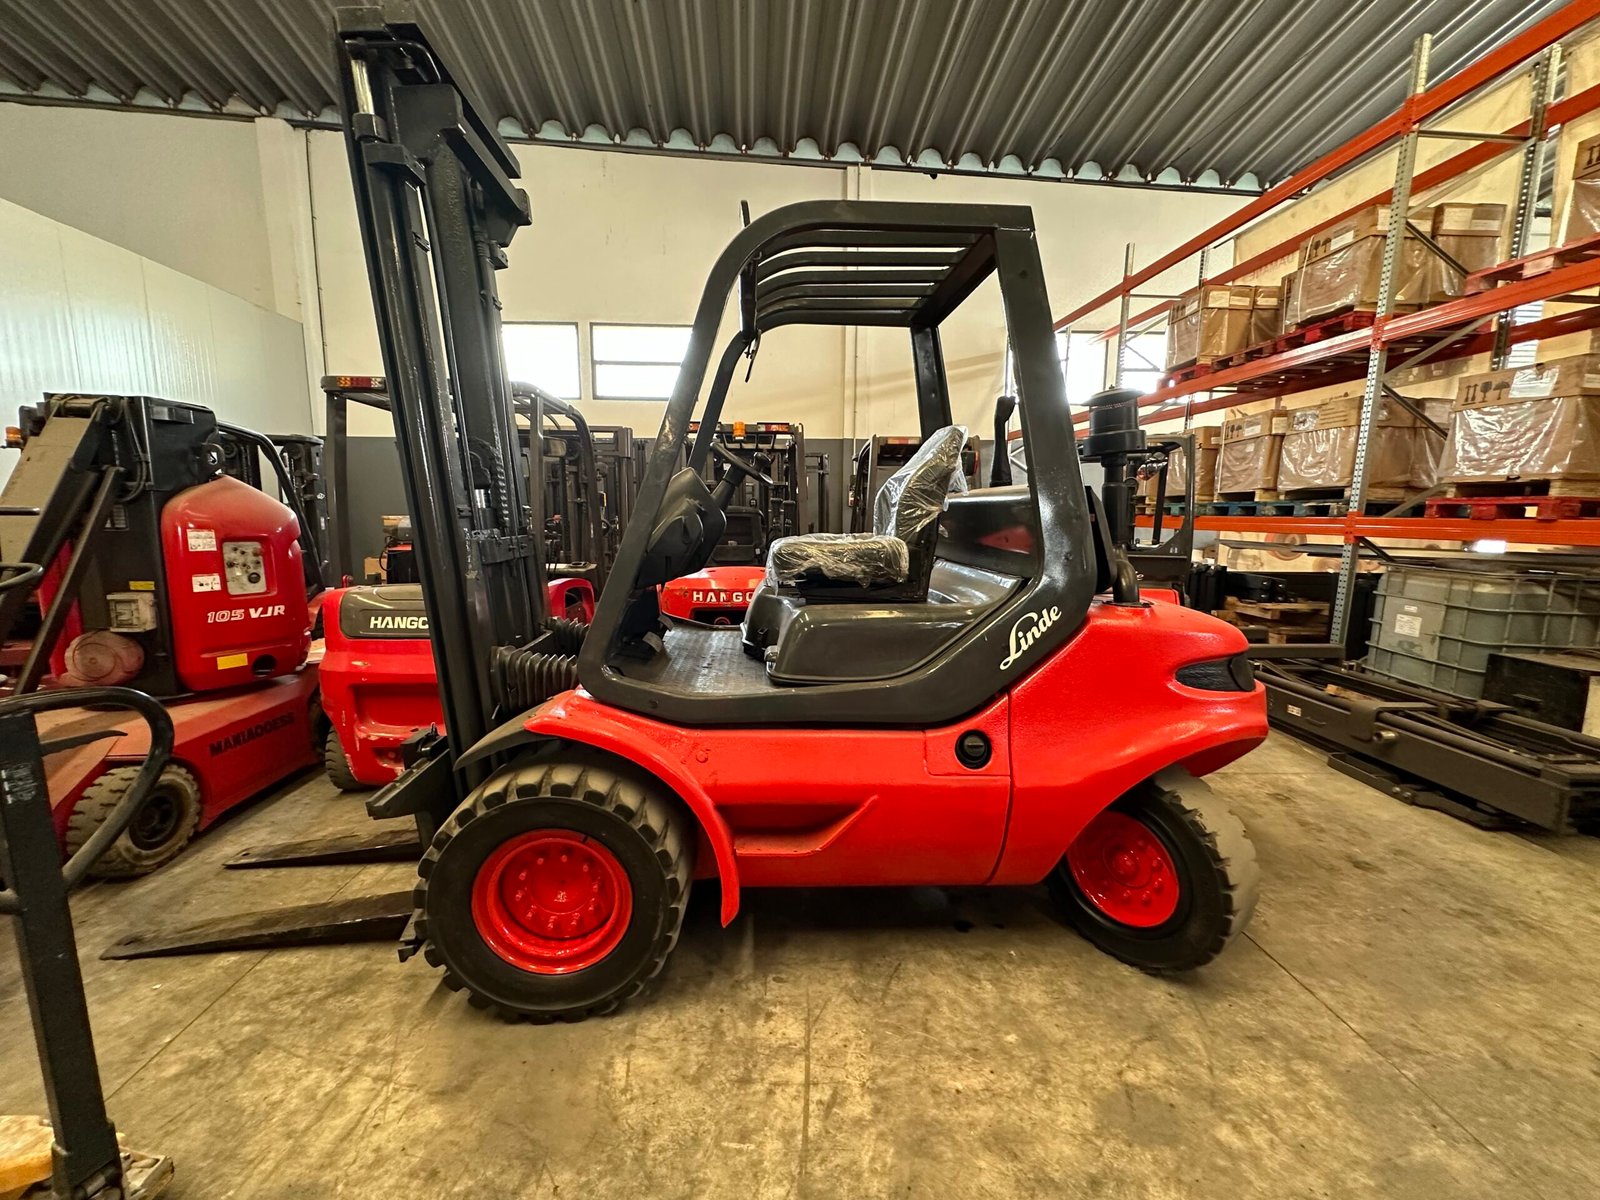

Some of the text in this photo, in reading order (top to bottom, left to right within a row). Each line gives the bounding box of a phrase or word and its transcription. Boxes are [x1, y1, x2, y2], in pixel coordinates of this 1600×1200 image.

[207, 604, 286, 624] 105 VJR
[369, 616, 429, 630] HANGC
[999, 605, 1062, 671] Linde
